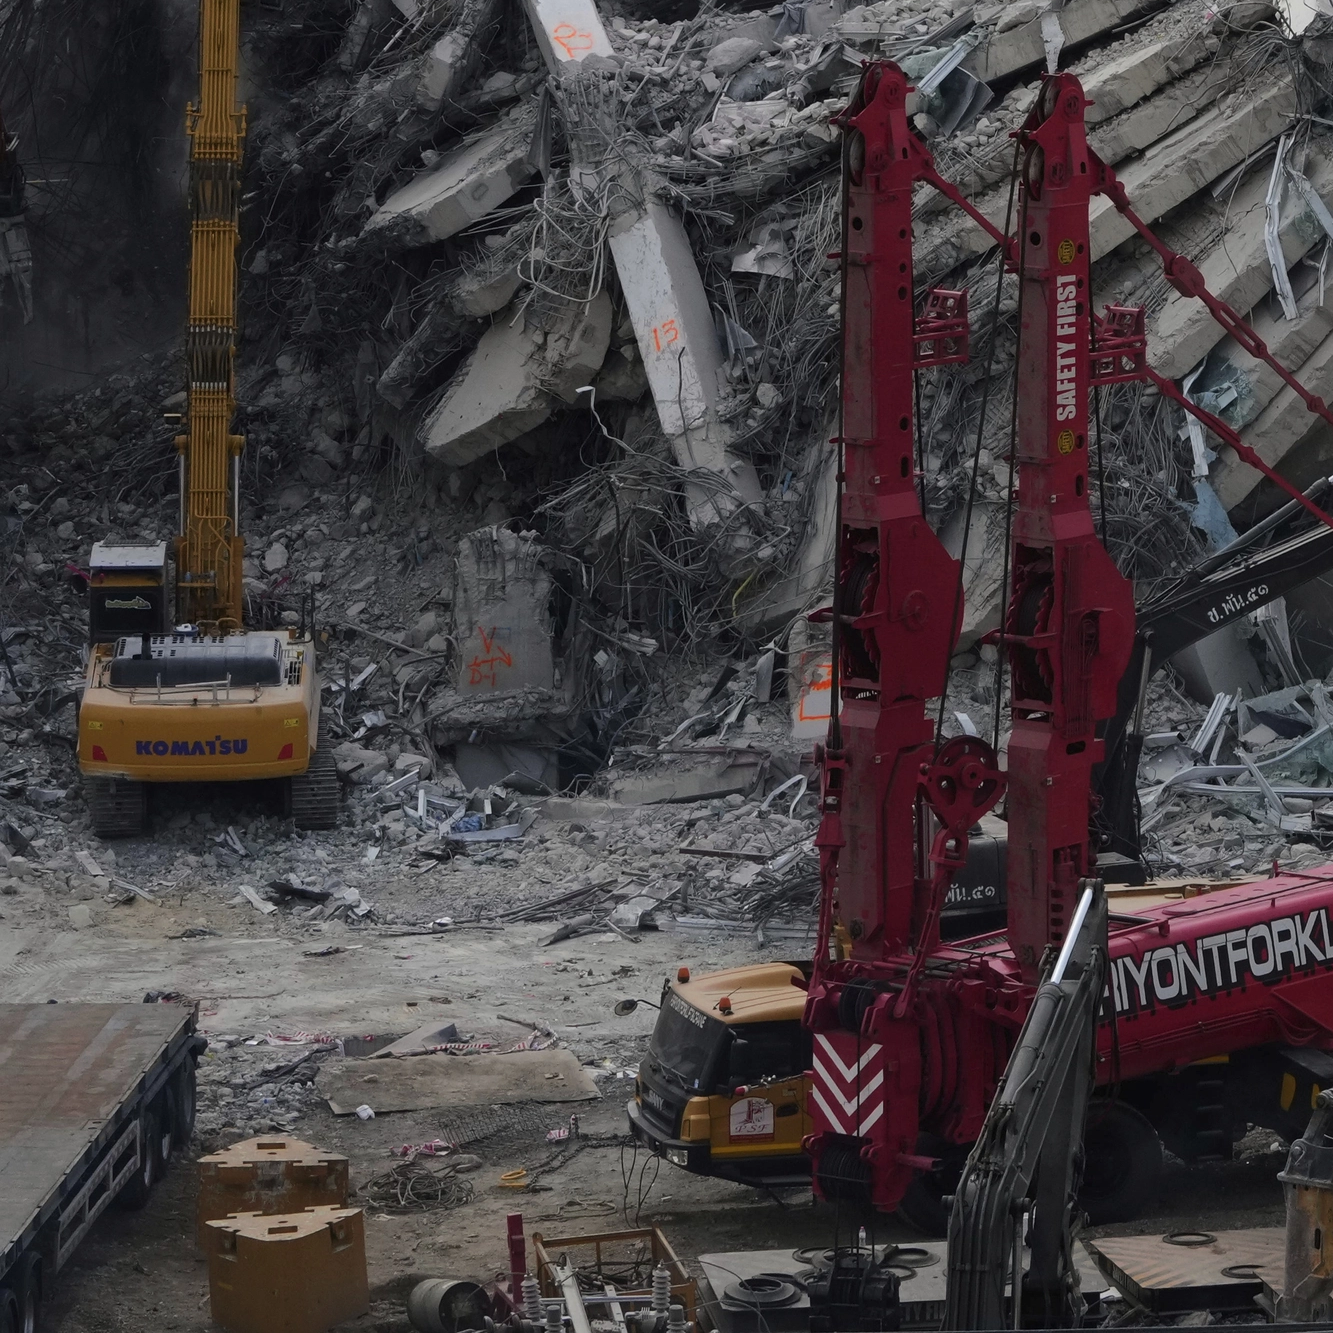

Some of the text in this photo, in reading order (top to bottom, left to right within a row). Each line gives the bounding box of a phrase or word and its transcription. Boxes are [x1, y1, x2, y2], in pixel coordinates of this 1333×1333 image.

[1056, 274, 1077, 422] SAFETY FIRST
[136, 734, 248, 756] KOMATSU
